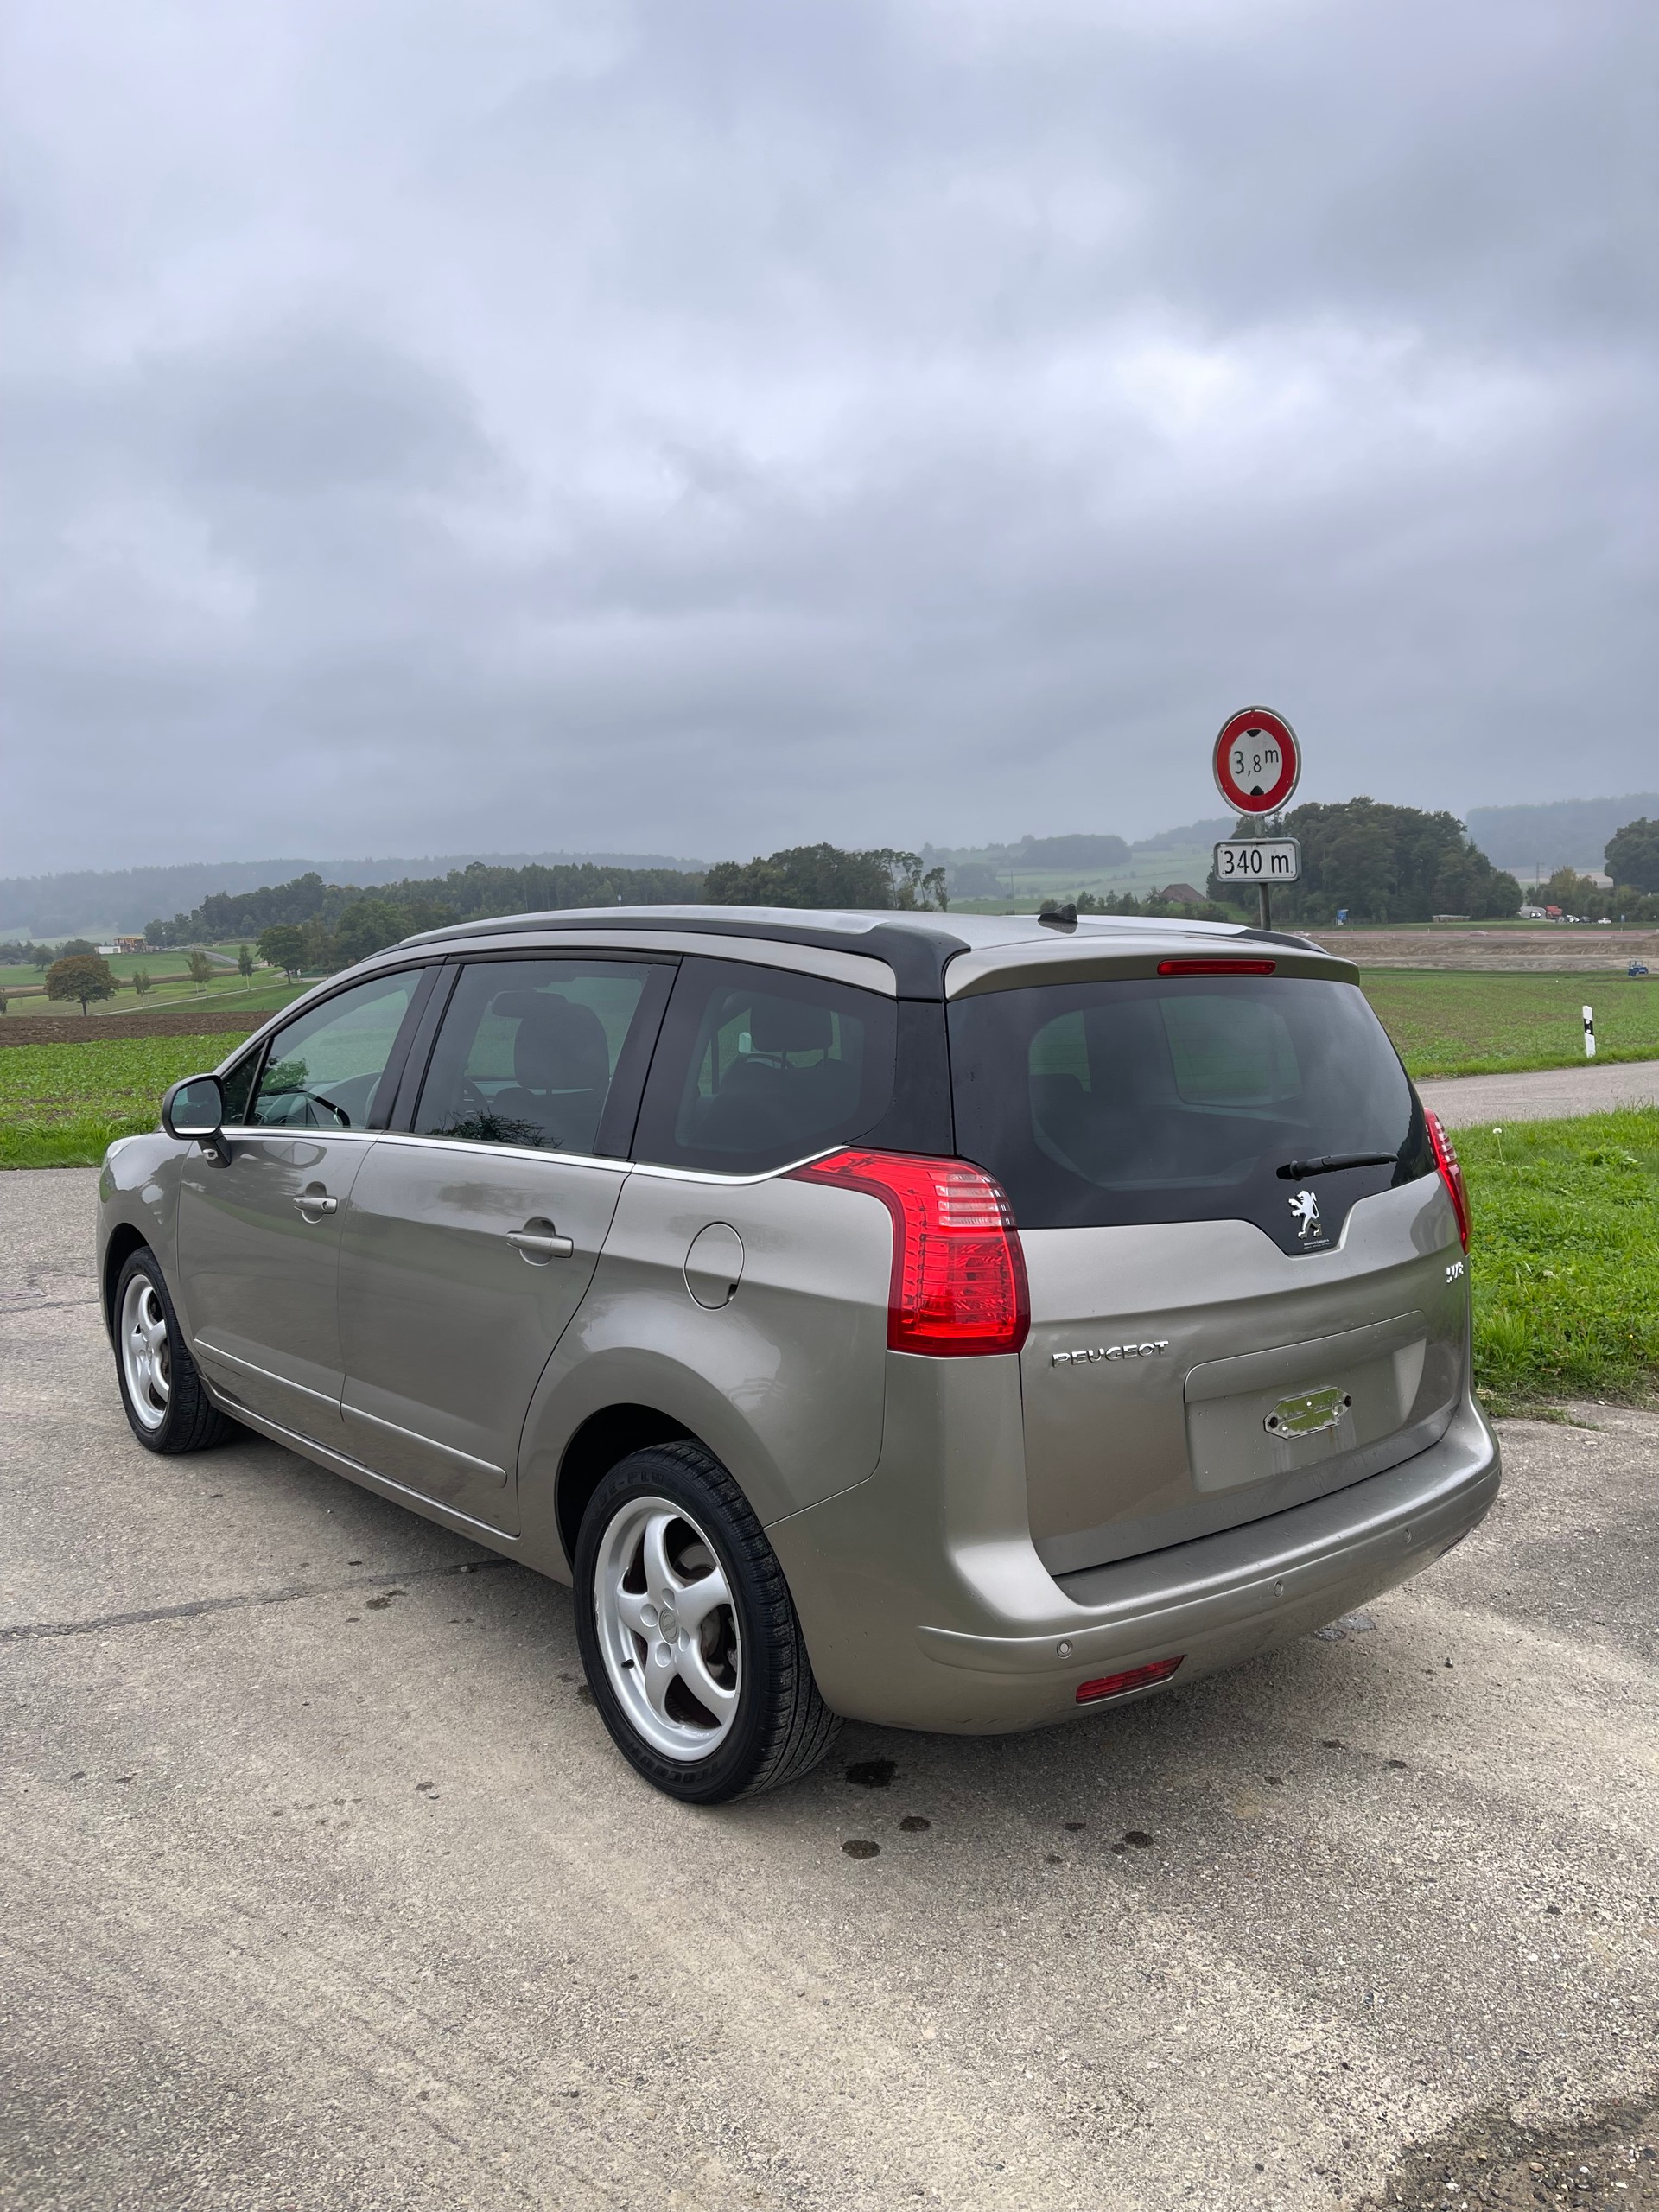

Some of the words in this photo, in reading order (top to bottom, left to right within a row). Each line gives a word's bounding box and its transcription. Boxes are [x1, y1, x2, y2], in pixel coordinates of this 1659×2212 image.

[1224, 849, 1262, 874] 340
[1271, 854, 1290, 874] m
[1052, 1340, 1169, 1368] PEUGEOT
